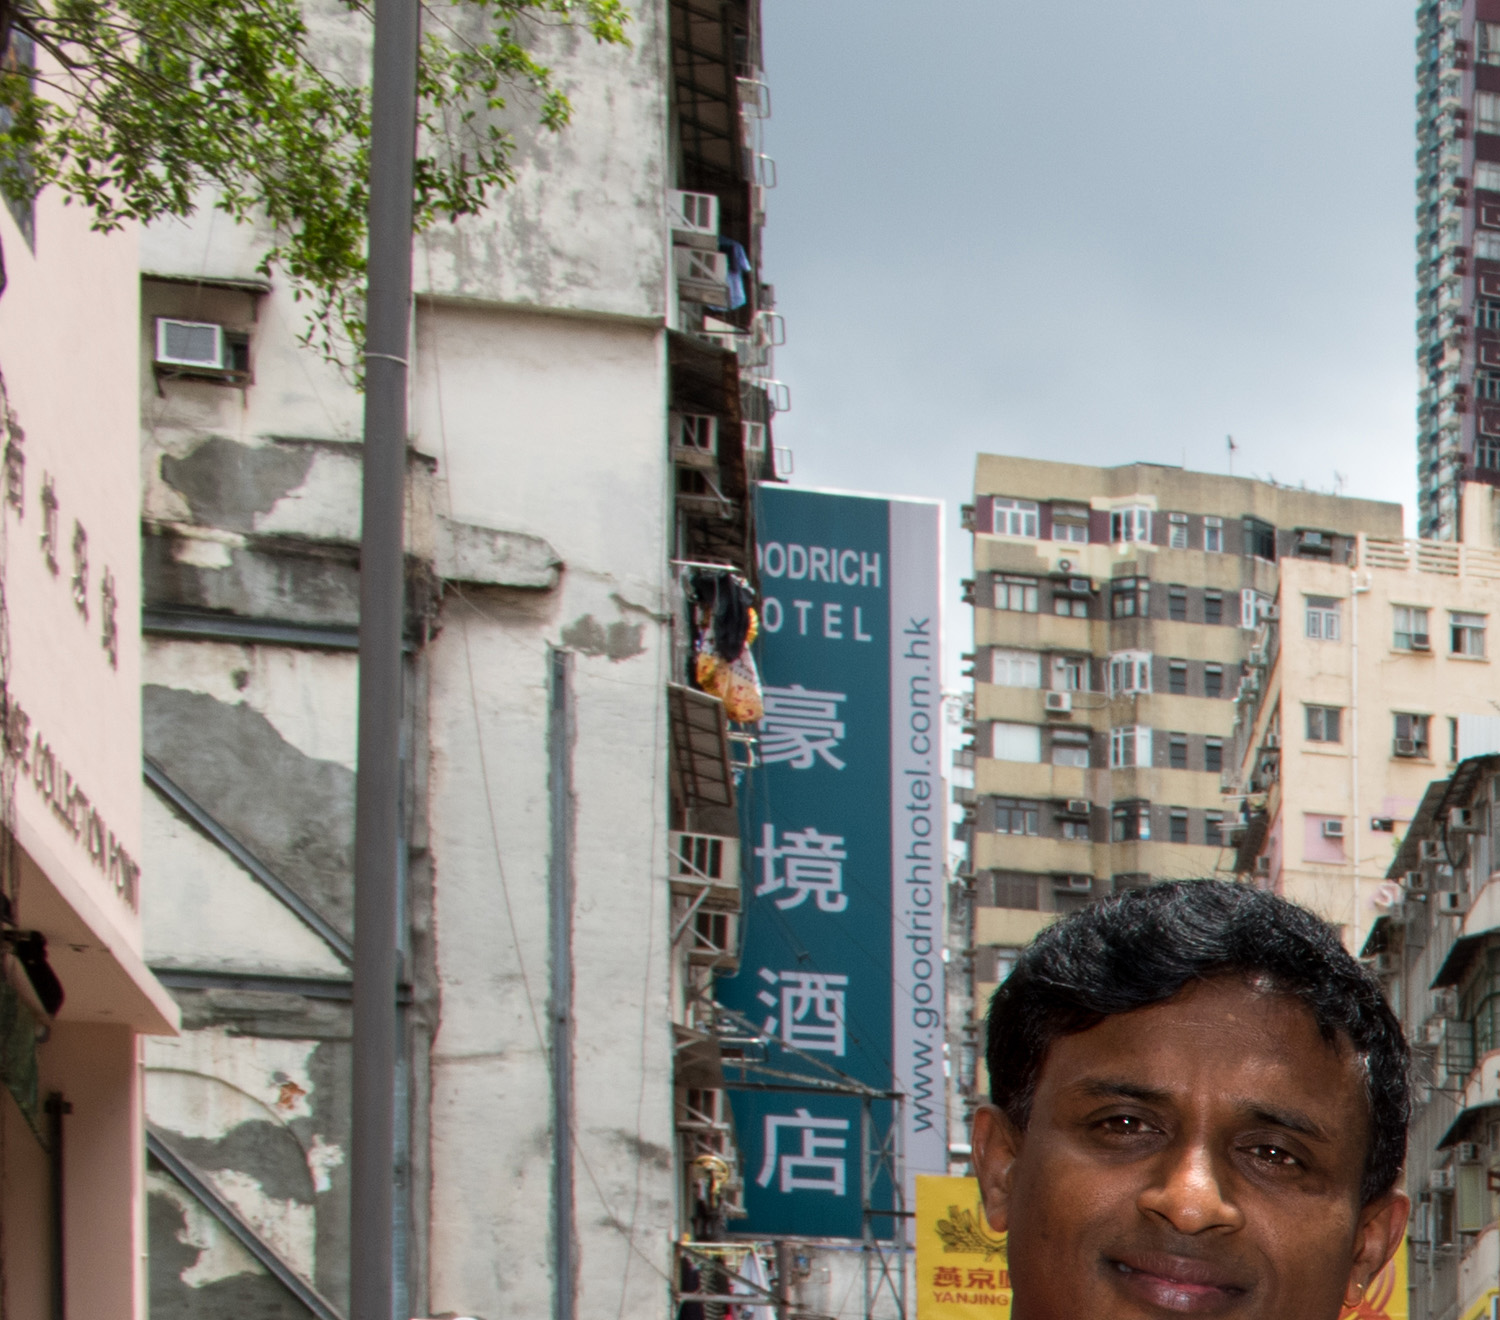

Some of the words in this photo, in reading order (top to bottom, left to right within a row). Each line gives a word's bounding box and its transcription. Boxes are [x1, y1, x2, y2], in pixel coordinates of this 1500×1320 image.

[757, 542, 882, 588] ODRICH
[761, 597, 873, 643] OTEL
[904, 615, 942, 1134] www.goodrichhotel.com.hk
[756, 684, 849, 1196] 豪境酒店
[932, 1290, 1010, 1306] YANJING
